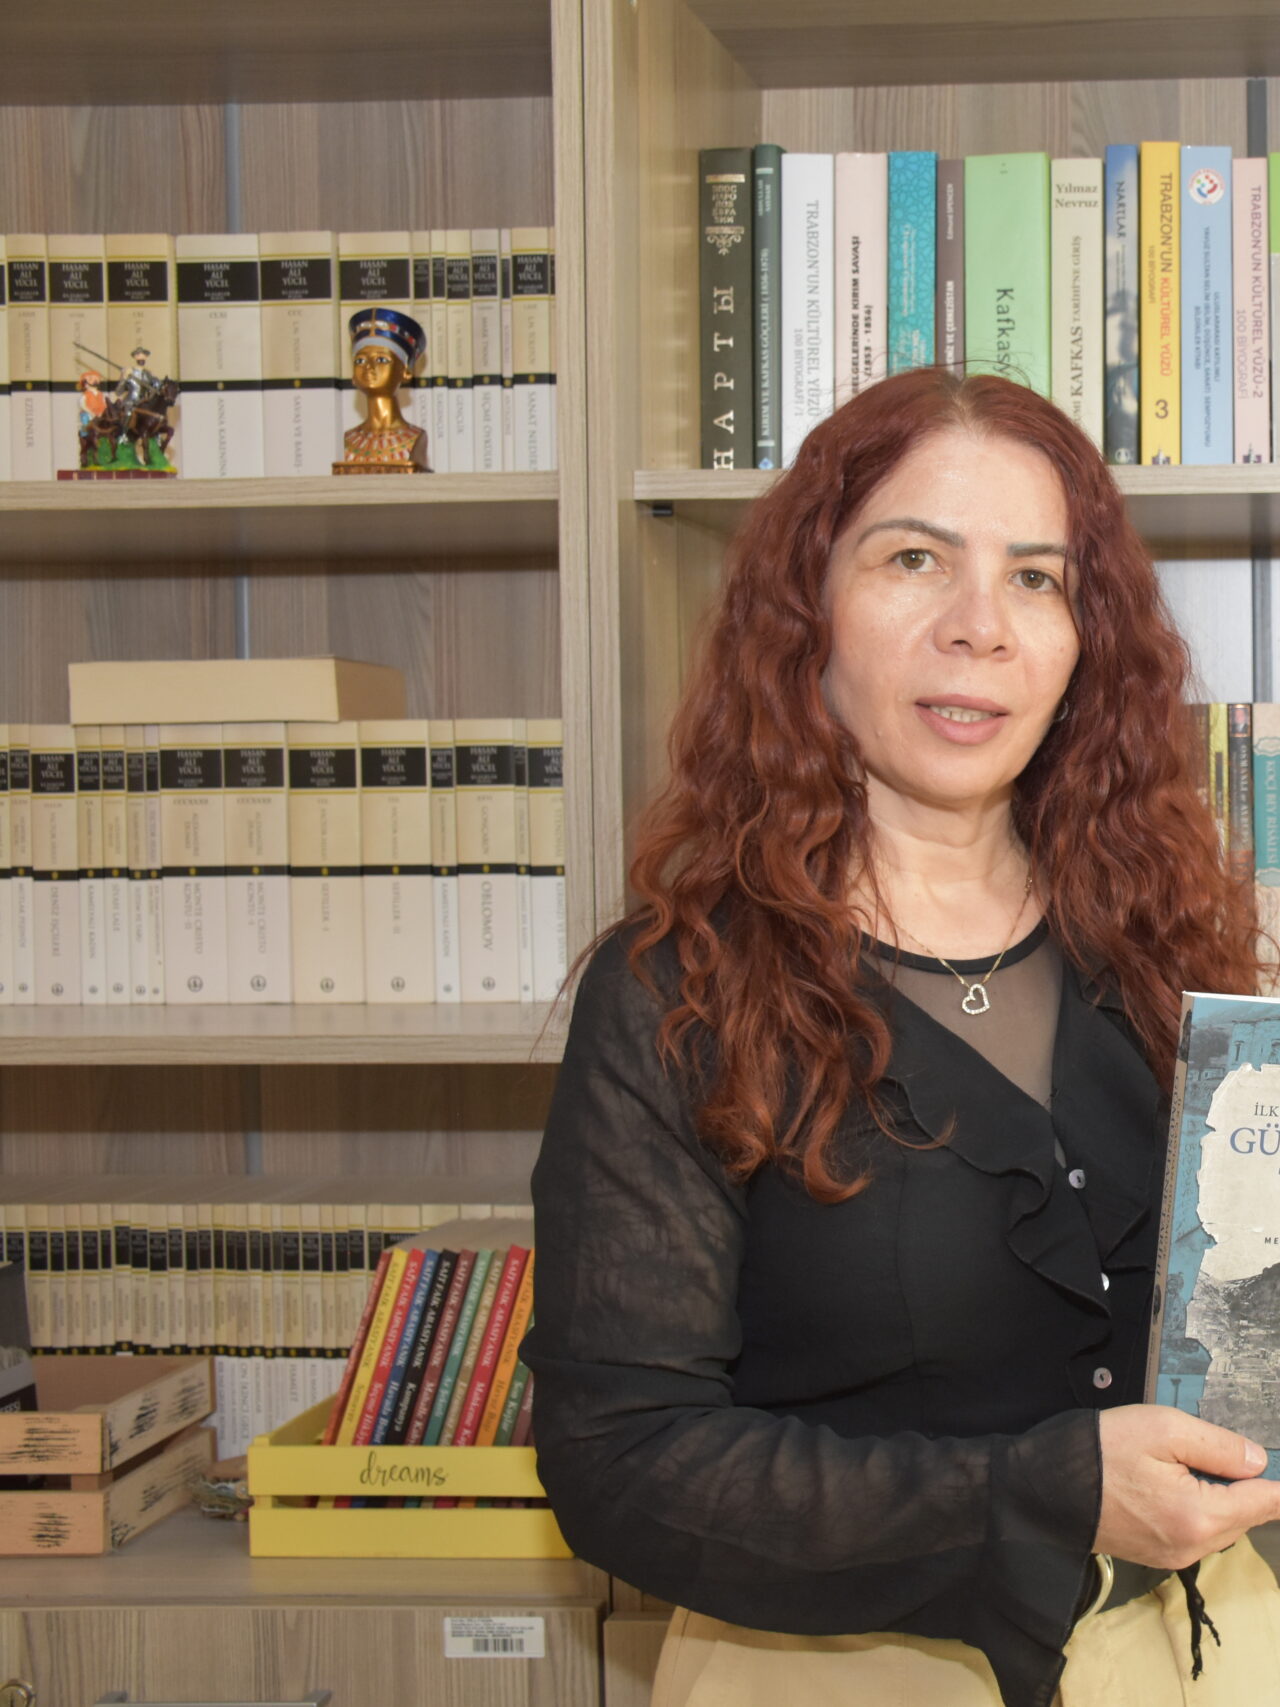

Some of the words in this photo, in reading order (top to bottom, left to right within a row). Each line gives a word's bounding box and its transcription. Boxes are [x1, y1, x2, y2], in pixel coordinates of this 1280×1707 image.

[1054, 197, 1099, 209] Nevruz
[1055, 183, 1098, 194] Yılmaz
[1114, 181, 1127, 239] NARTLAR
[1159, 172, 1174, 273] TRABZON'UN
[1250, 184, 1263, 273] TRABZON'UN
[1160, 277, 1173, 340] KÜLTÜREL
[1236, 309, 1247, 333] 100
[1251, 275, 1264, 345] KÜLTÜREL
[1160, 343, 1173, 377] YÜZÜ
[1236, 335, 1249, 400] BİYOGRAFİ
[1252, 347, 1265, 399] YÜZÜ-2
[215, 397, 227, 424] ANNA
[214, 426, 227, 477] KARENİNA
[481, 880, 495, 952] OBLOMOV
[1253, 1101, 1280, 1118] İLK
[359, 1450, 448, 1487] dreams
